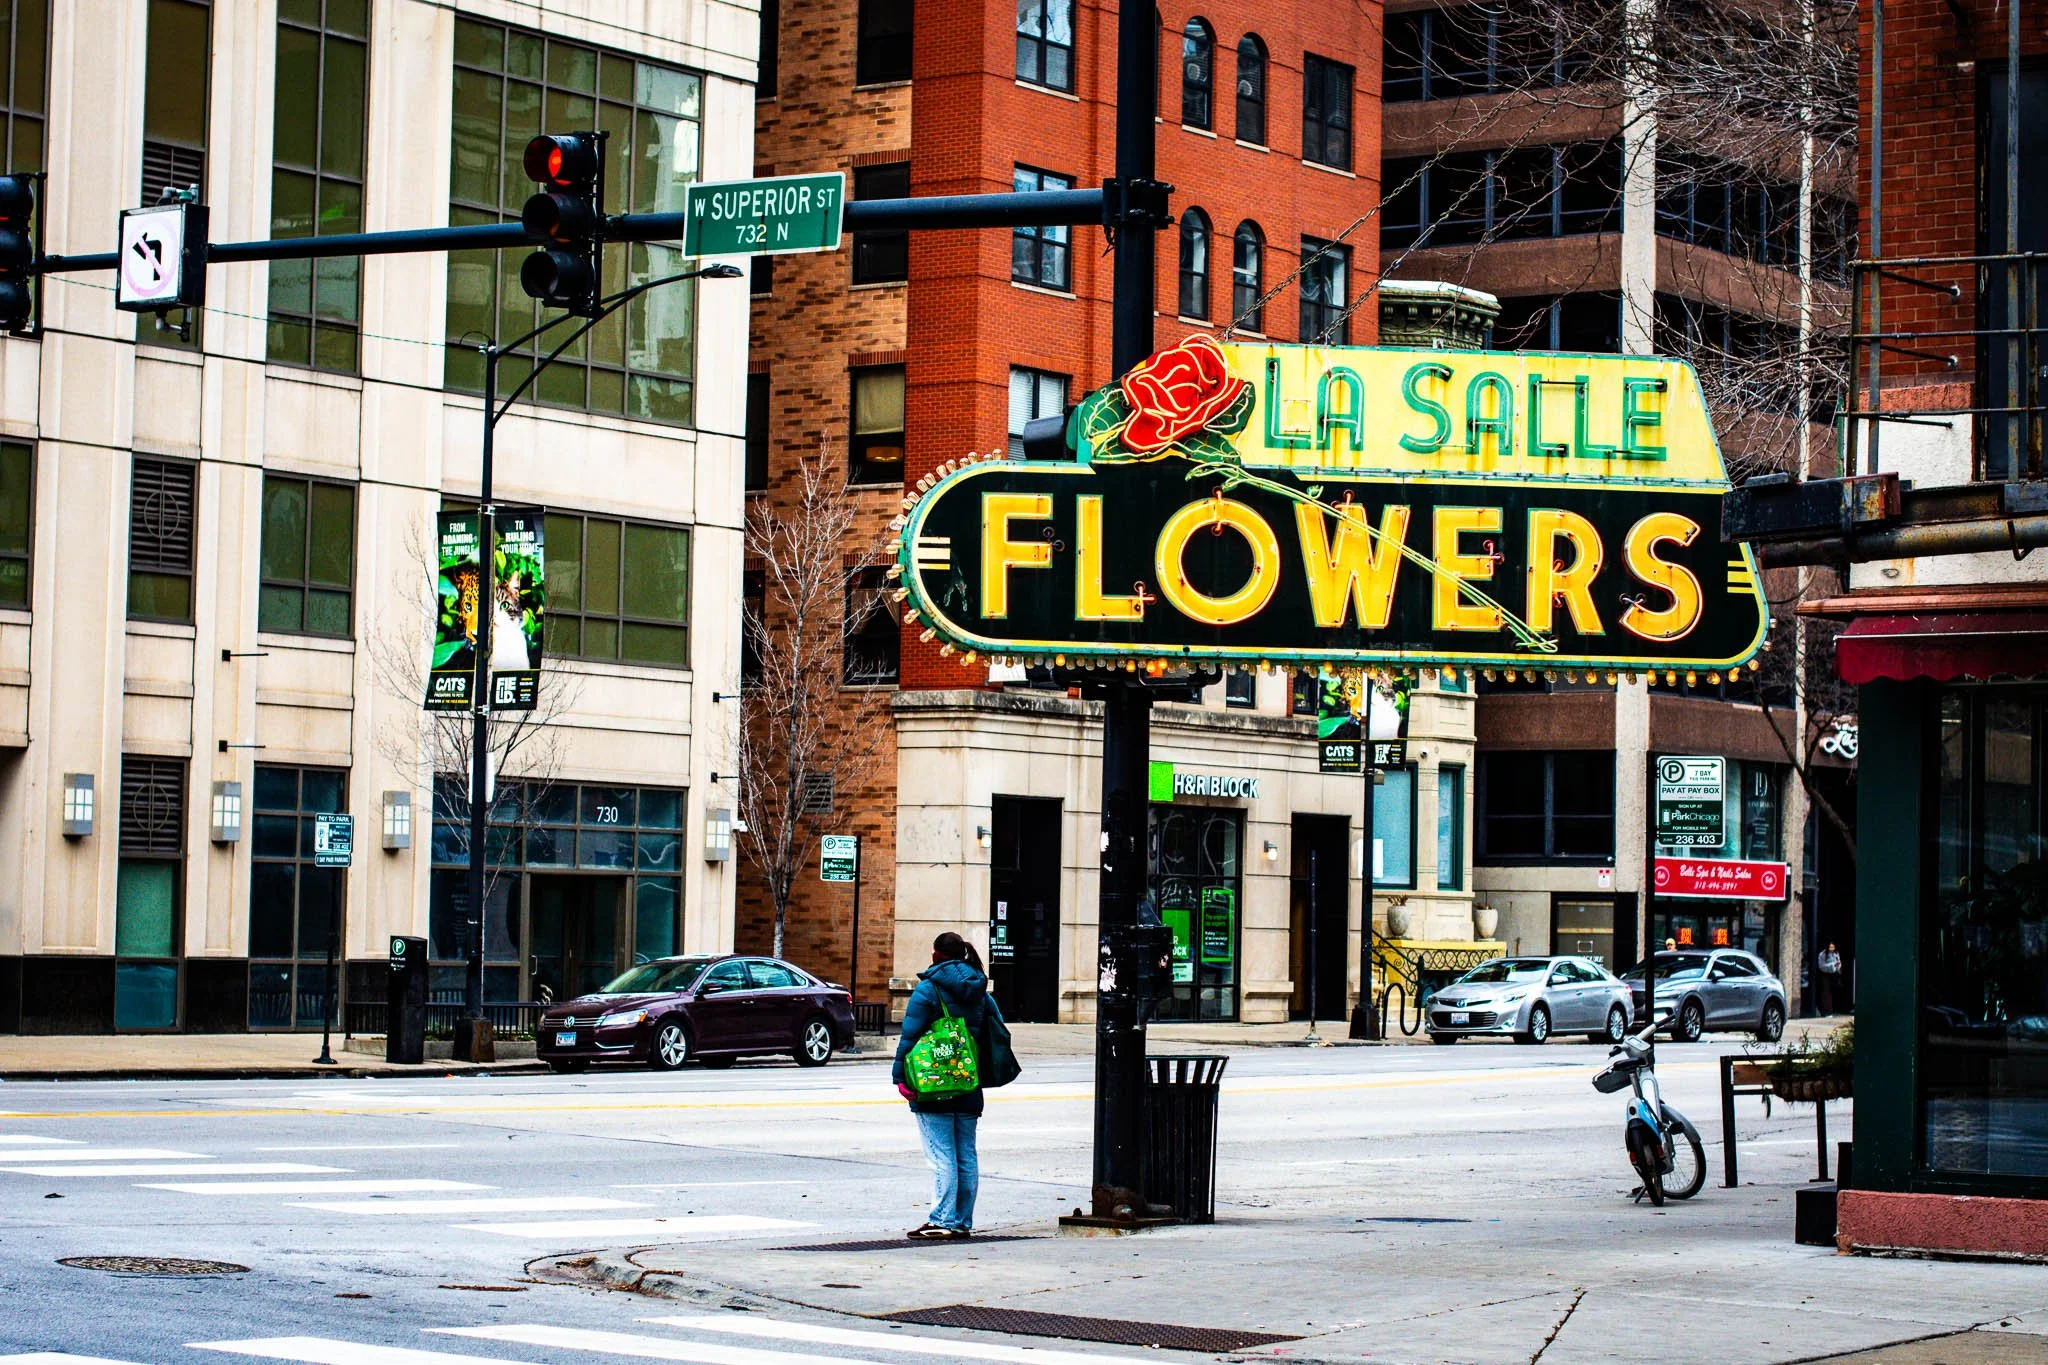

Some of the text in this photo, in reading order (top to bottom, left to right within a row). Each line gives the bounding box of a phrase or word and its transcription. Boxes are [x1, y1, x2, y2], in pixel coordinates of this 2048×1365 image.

[694, 186, 835, 220] W SUPERIOR ST
[735, 222, 789, 244] 732 N
[1264, 357, 1667, 462] LA SALLE
[449, 522, 466, 533] FROM
[515, 520, 524, 531] TO
[442, 533, 473, 545] ROAMING
[505, 531, 534, 542] RULING
[501, 543, 518, 554] YOUR
[980, 492, 1703, 643] FLOWERS
[435, 677, 467, 692] CATS
[1325, 745, 1354, 757] CATS
[1174, 773, 1259, 799] H&R BLOCK
[597, 806, 618, 823] 730
[1671, 812, 1720, 823] ParkChicago
[1675, 835, 1716, 844] 236 403
[1696, 865, 1709, 880] Spa
[1710, 868, 1717, 878] &
[1717, 866, 1734, 880] Nails
[1734, 866, 1752, 880] Salon
